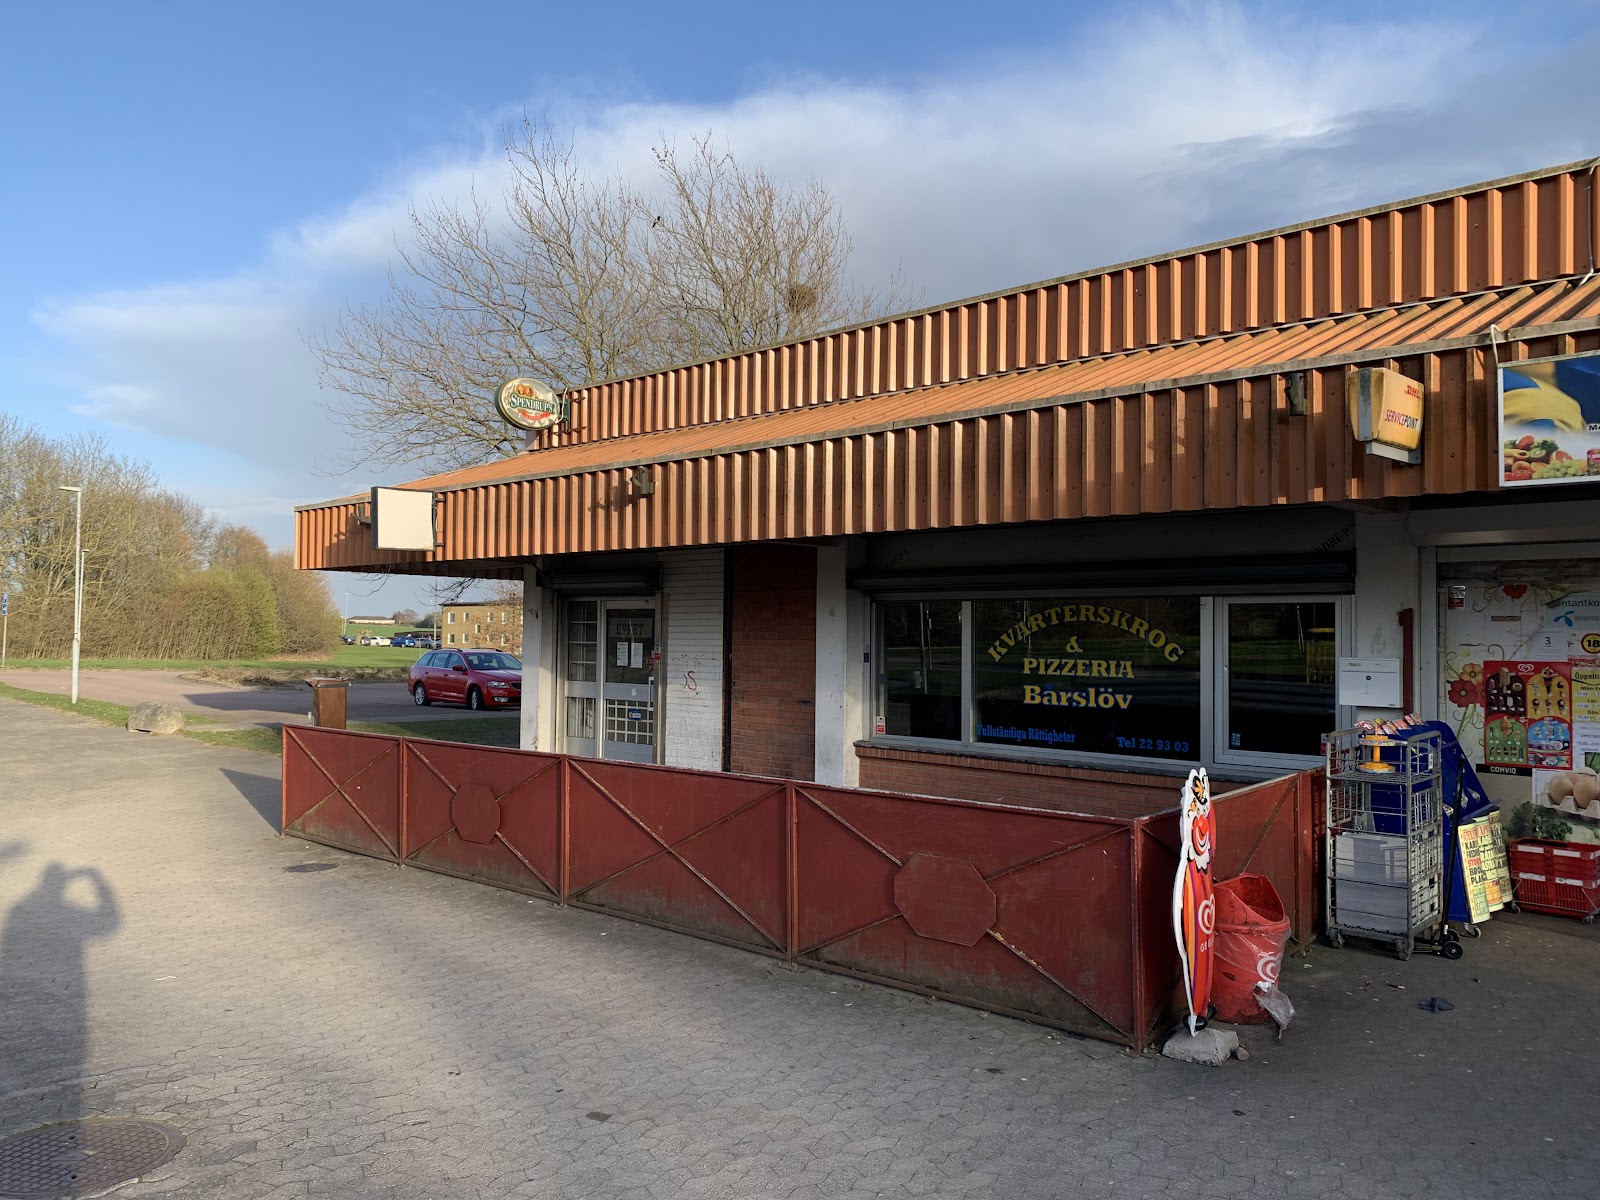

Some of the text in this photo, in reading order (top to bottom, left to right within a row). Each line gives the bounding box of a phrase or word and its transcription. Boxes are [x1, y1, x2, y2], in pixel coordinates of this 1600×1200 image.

[1404, 384, 1421, 400] DHL
[987, 604, 1185, 662] KVARTERSKROG
[1544, 636, 1551, 645] 3
[1065, 635, 1083, 653] &
[1586, 639, 1600, 648] 18
[1023, 657, 1135, 678] PIZZERIA
[977, 724, 1076, 745] Fullständiga Rättigheter
[1117, 737, 1189, 753] Tel 22 93 03
[1490, 765, 1517, 775] COMVIQ
